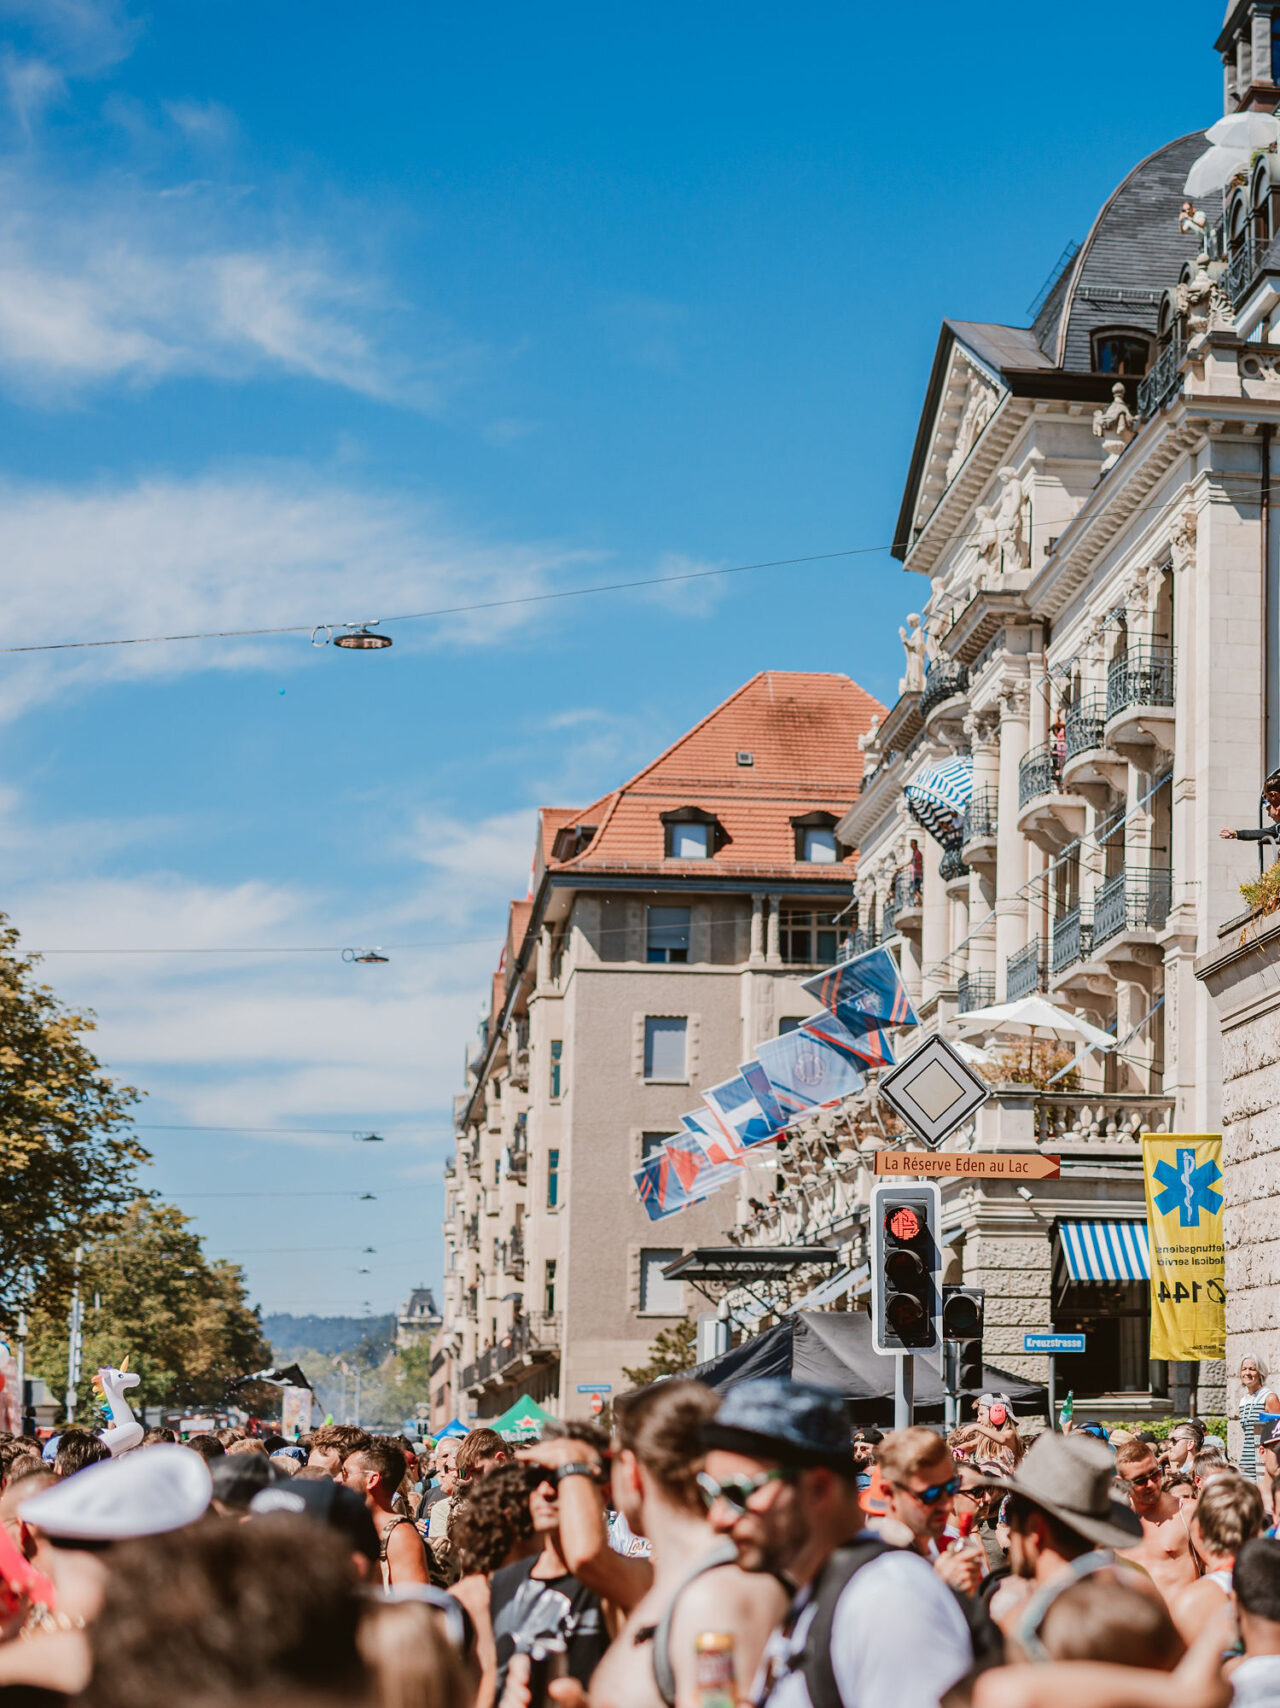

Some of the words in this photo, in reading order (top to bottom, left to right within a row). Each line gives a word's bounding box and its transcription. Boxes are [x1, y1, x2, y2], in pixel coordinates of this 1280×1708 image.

[885, 1157, 898, 1170] La
[903, 1156, 951, 1171] Réserve
[956, 1158, 985, 1172] Eden
[990, 1162, 1004, 1173] au
[1009, 1160, 1029, 1173] Lac
[1026, 1337, 1082, 1348] Kreuzstrasse
